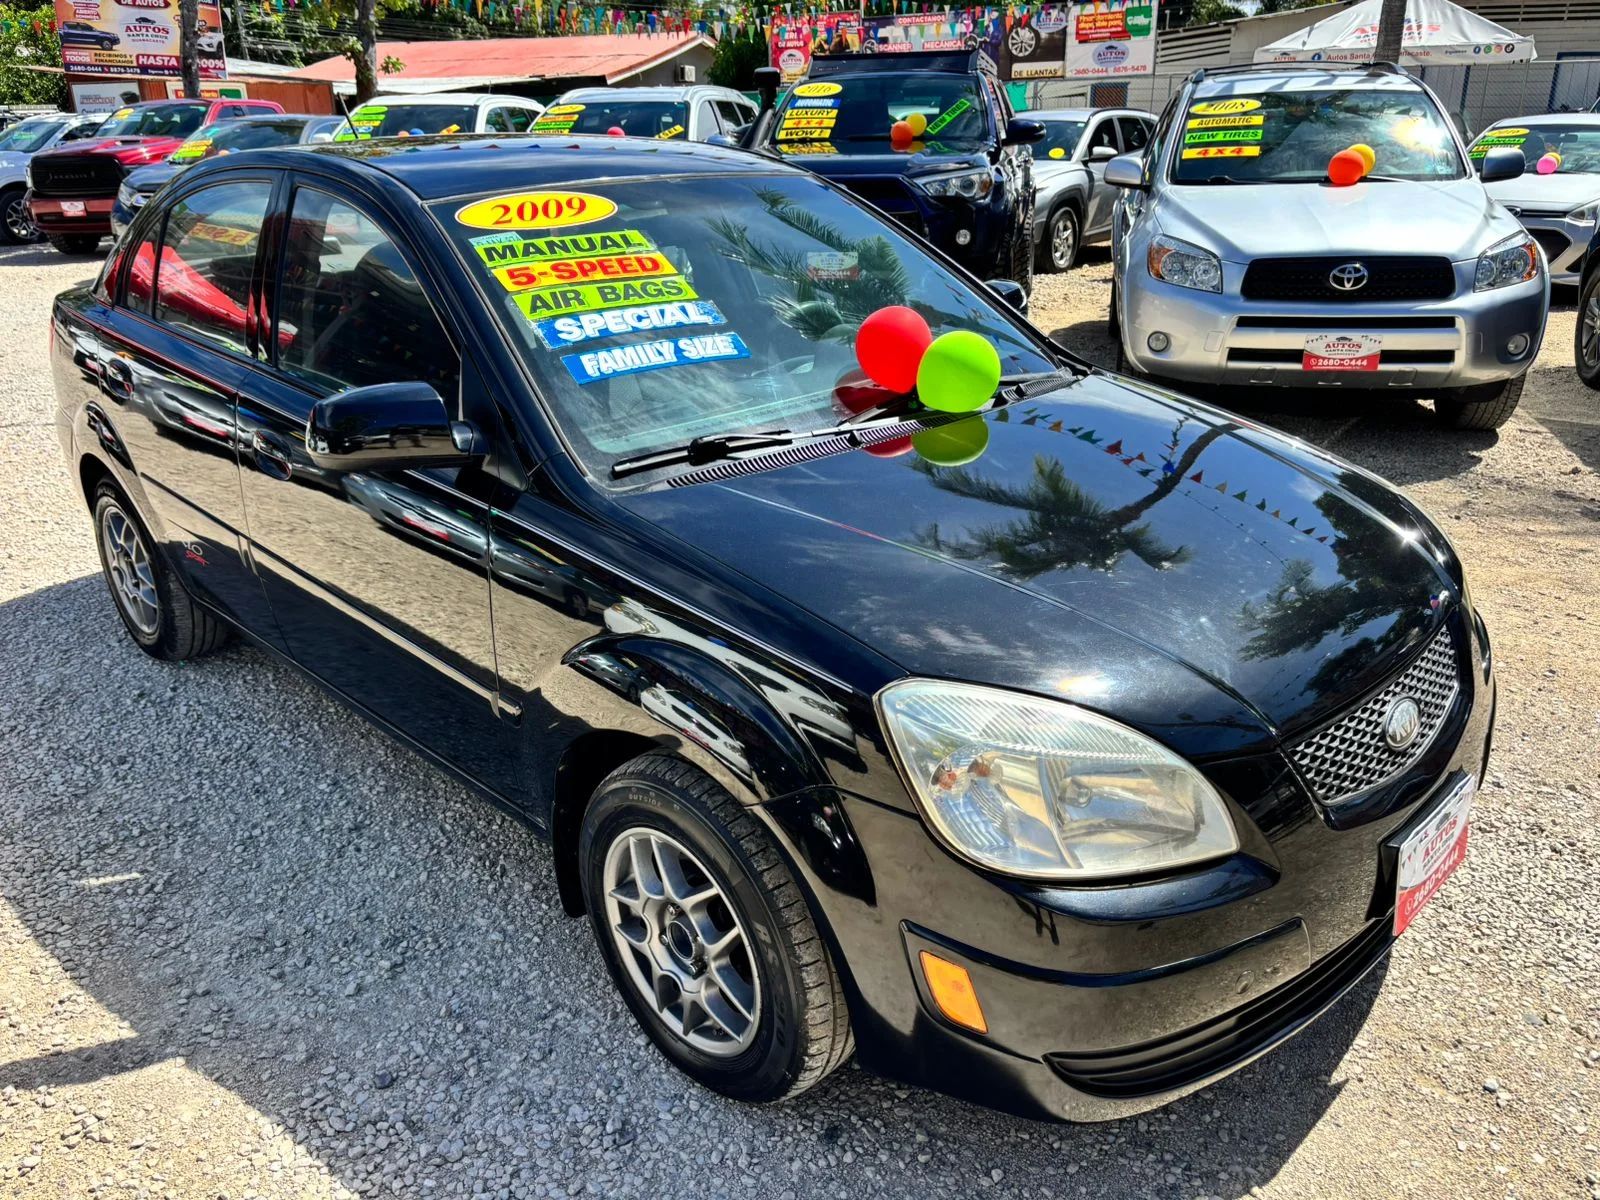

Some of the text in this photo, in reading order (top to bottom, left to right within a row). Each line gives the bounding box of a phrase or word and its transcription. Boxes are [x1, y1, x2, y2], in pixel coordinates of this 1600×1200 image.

[125, 25, 169, 35] AUTOS
[138, 55, 178, 66] HASTA
[1326, 53, 1348, 61] Autos
[1349, 52, 1371, 60] Santa
[1074, 67, 1108, 75] 2680-0444
[929, 114, 947, 132] NEW
[944, 100, 969, 118] TIRES
[1197, 116, 1253, 127] AUTOMATIC
[785, 129, 816, 137] WOW
[1188, 130, 1259, 141] NEW TIRES
[1195, 148, 1210, 157] 4
[1229, 147, 1243, 155] 4
[491, 196, 588, 226] 2009
[485, 232, 645, 263] MANUAL
[506, 255, 662, 288] 5-SPEED
[528, 278, 685, 316] AIR BAGS
[554, 301, 712, 341] SPECIAL
[579, 334, 739, 378] FAMILY SIZE
[1317, 358, 1368, 366] 2680-0444
[1422, 815, 1459, 863] AUTOS
[1413, 844, 1460, 909] 2680-0444
